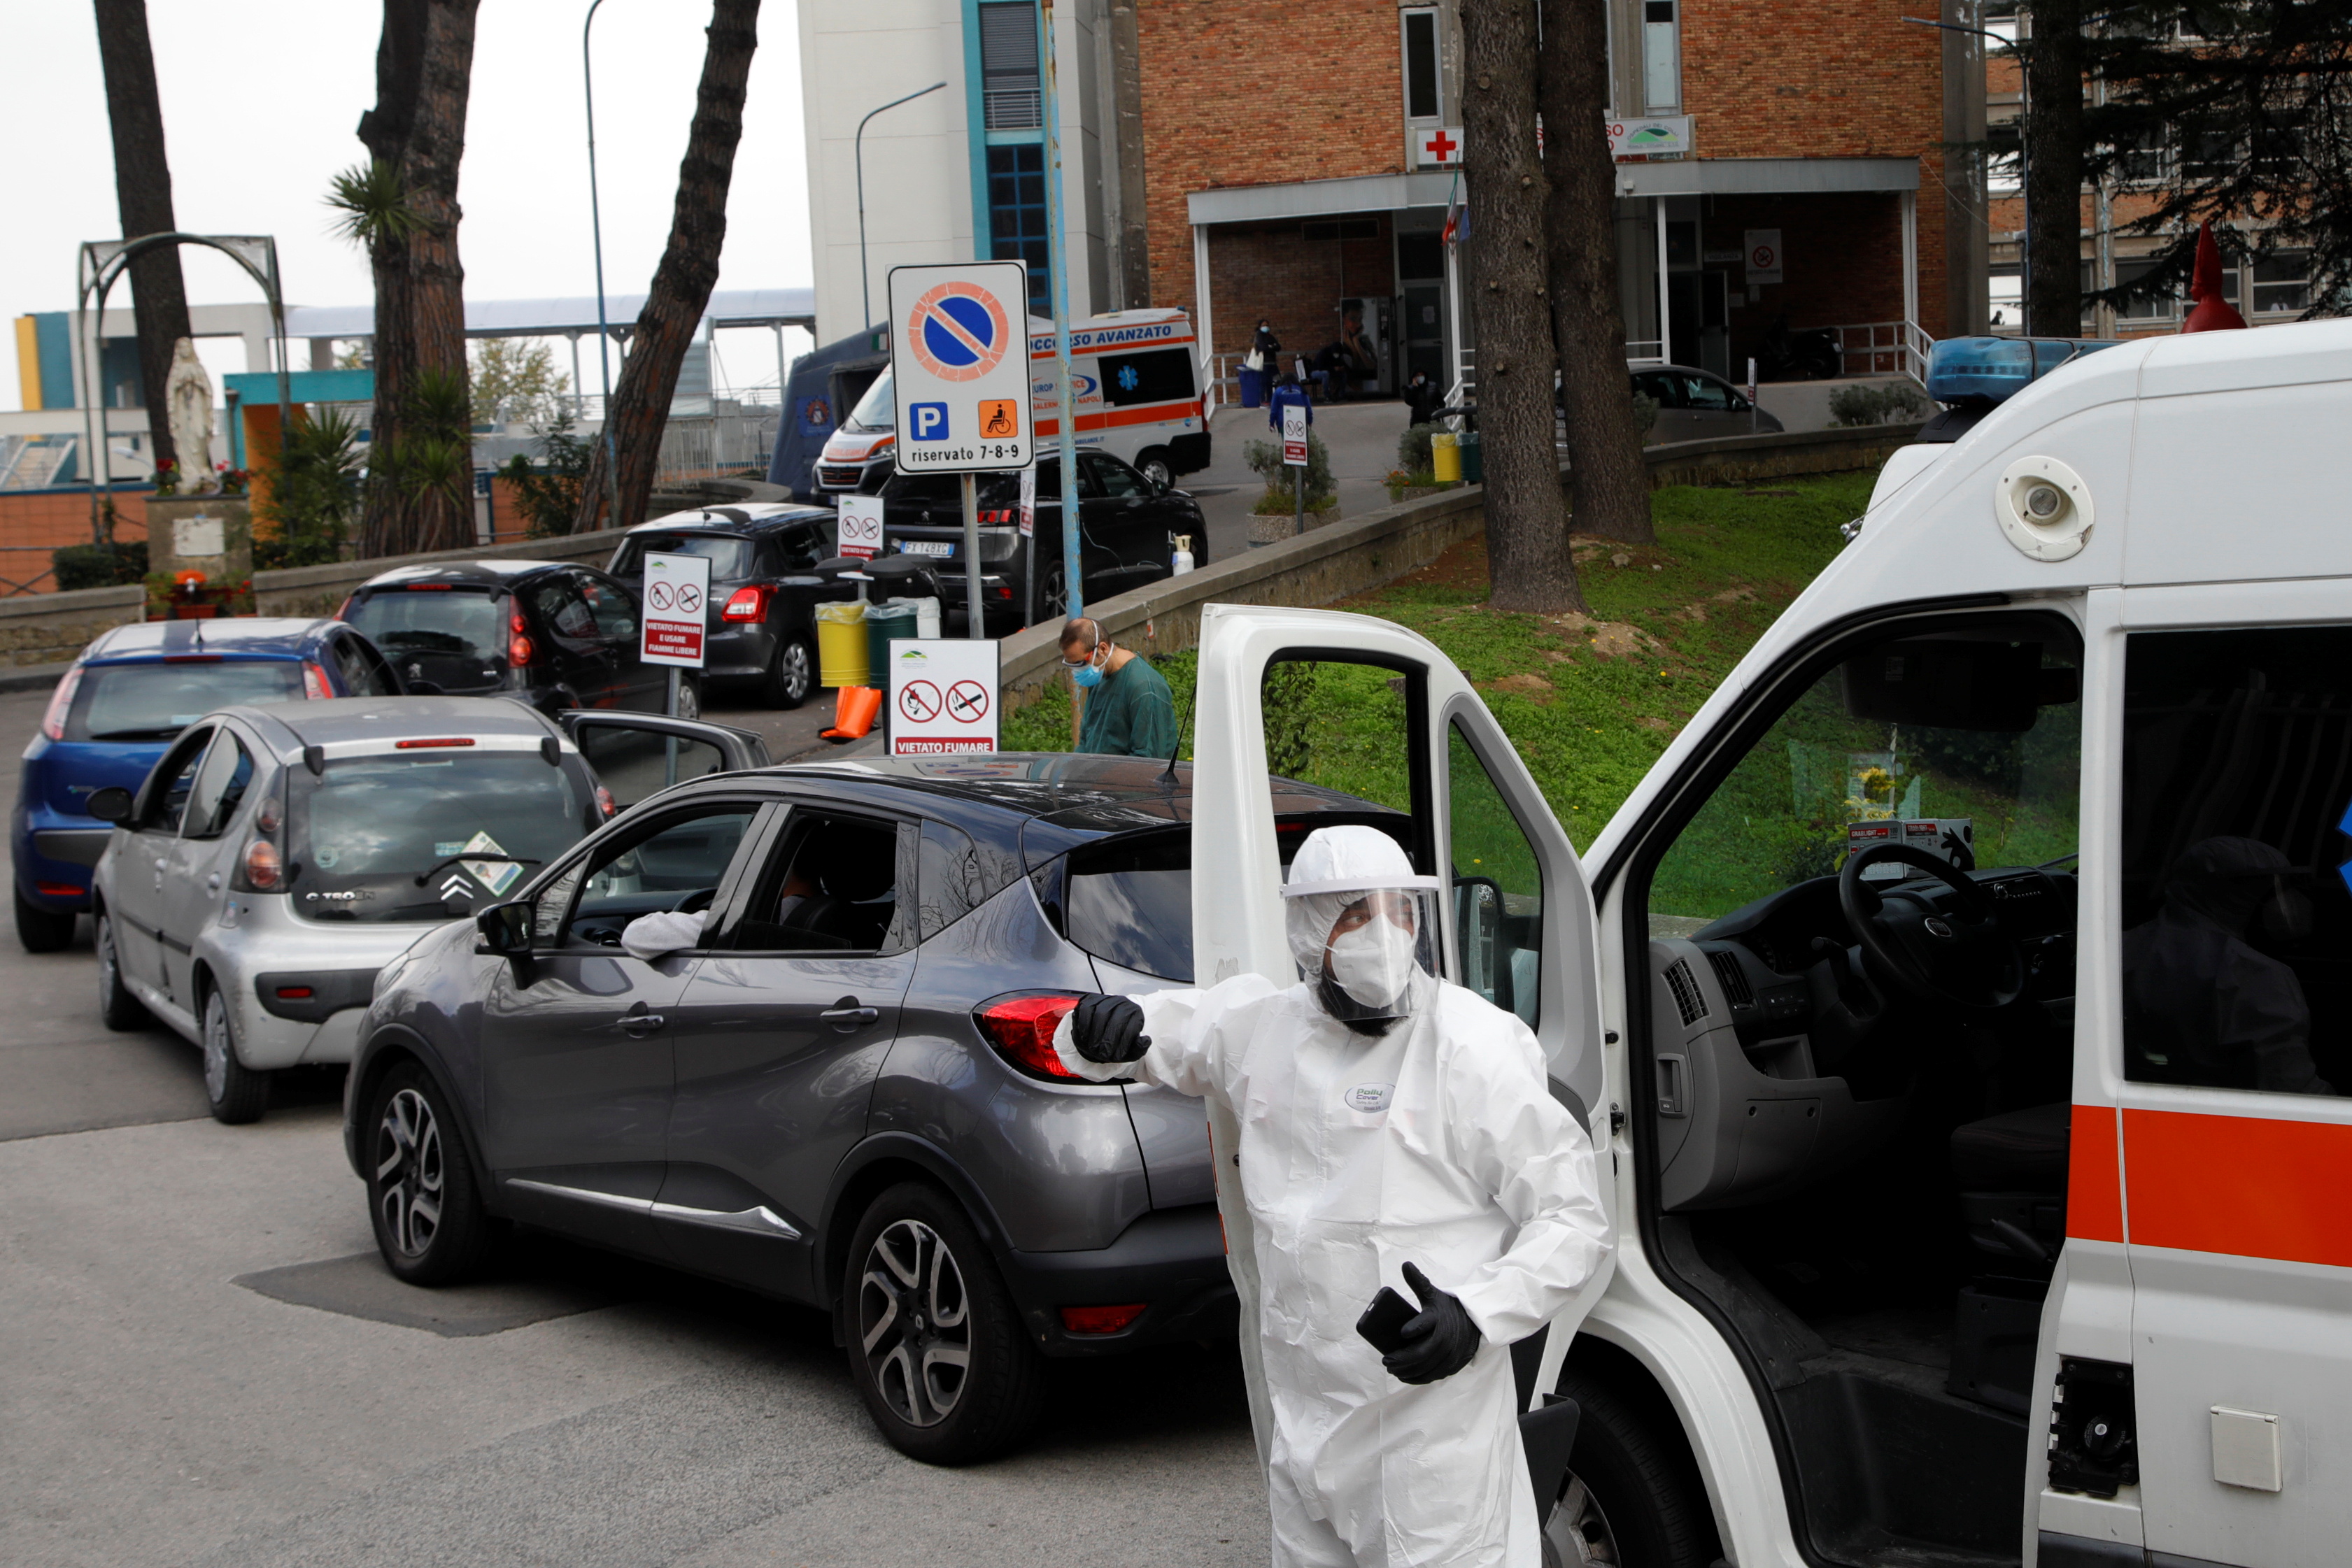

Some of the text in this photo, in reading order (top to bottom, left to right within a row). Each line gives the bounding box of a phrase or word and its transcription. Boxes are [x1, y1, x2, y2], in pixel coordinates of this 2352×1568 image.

[1097, 325, 1172, 344] AVANZATO
[1032, 383, 1054, 393] UROP
[1077, 395, 1102, 404] NAPOLI
[917, 407, 941, 436] P
[912, 444, 1019, 462] riservato 7-8-9
[646, 622, 701, 634] VIETATO FUMARE
[665, 635, 686, 643] USARE
[649, 644, 697, 655] FIAMME LIBERE
[898, 742, 991, 753] VIETATO FUMARE
